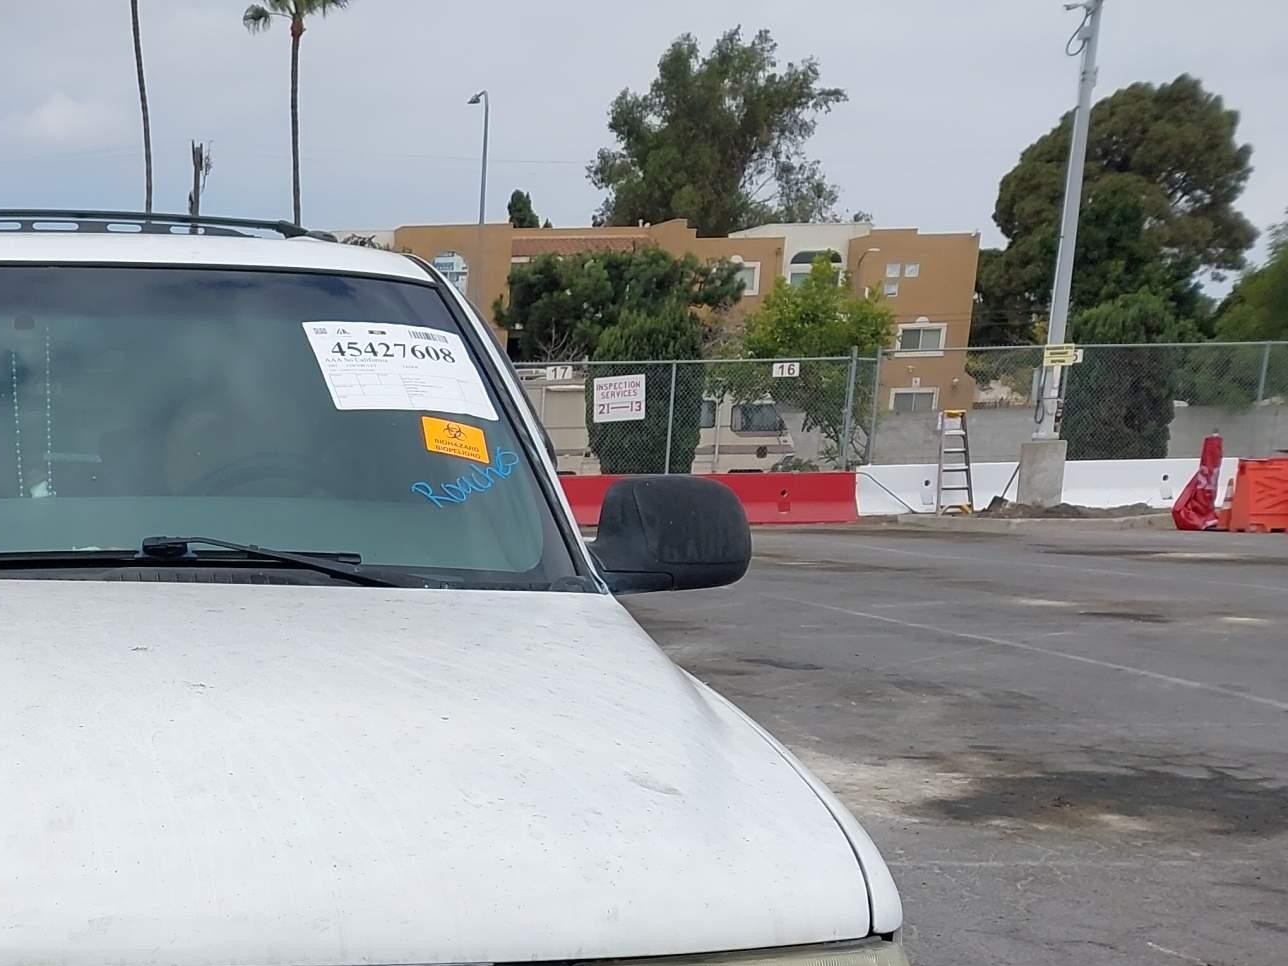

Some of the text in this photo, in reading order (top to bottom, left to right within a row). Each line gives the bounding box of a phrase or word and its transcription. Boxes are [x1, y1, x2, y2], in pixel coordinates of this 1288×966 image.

[331, 341, 456, 363] 45427608
[552, 366, 569, 379] 17
[778, 363, 796, 376] 16
[596, 380, 641, 391] INSPECTION
[601, 389, 638, 400] SERVICES
[434, 438, 480, 453] BIOHAZARD
[435, 444, 481, 460] BIOPELIGRO
